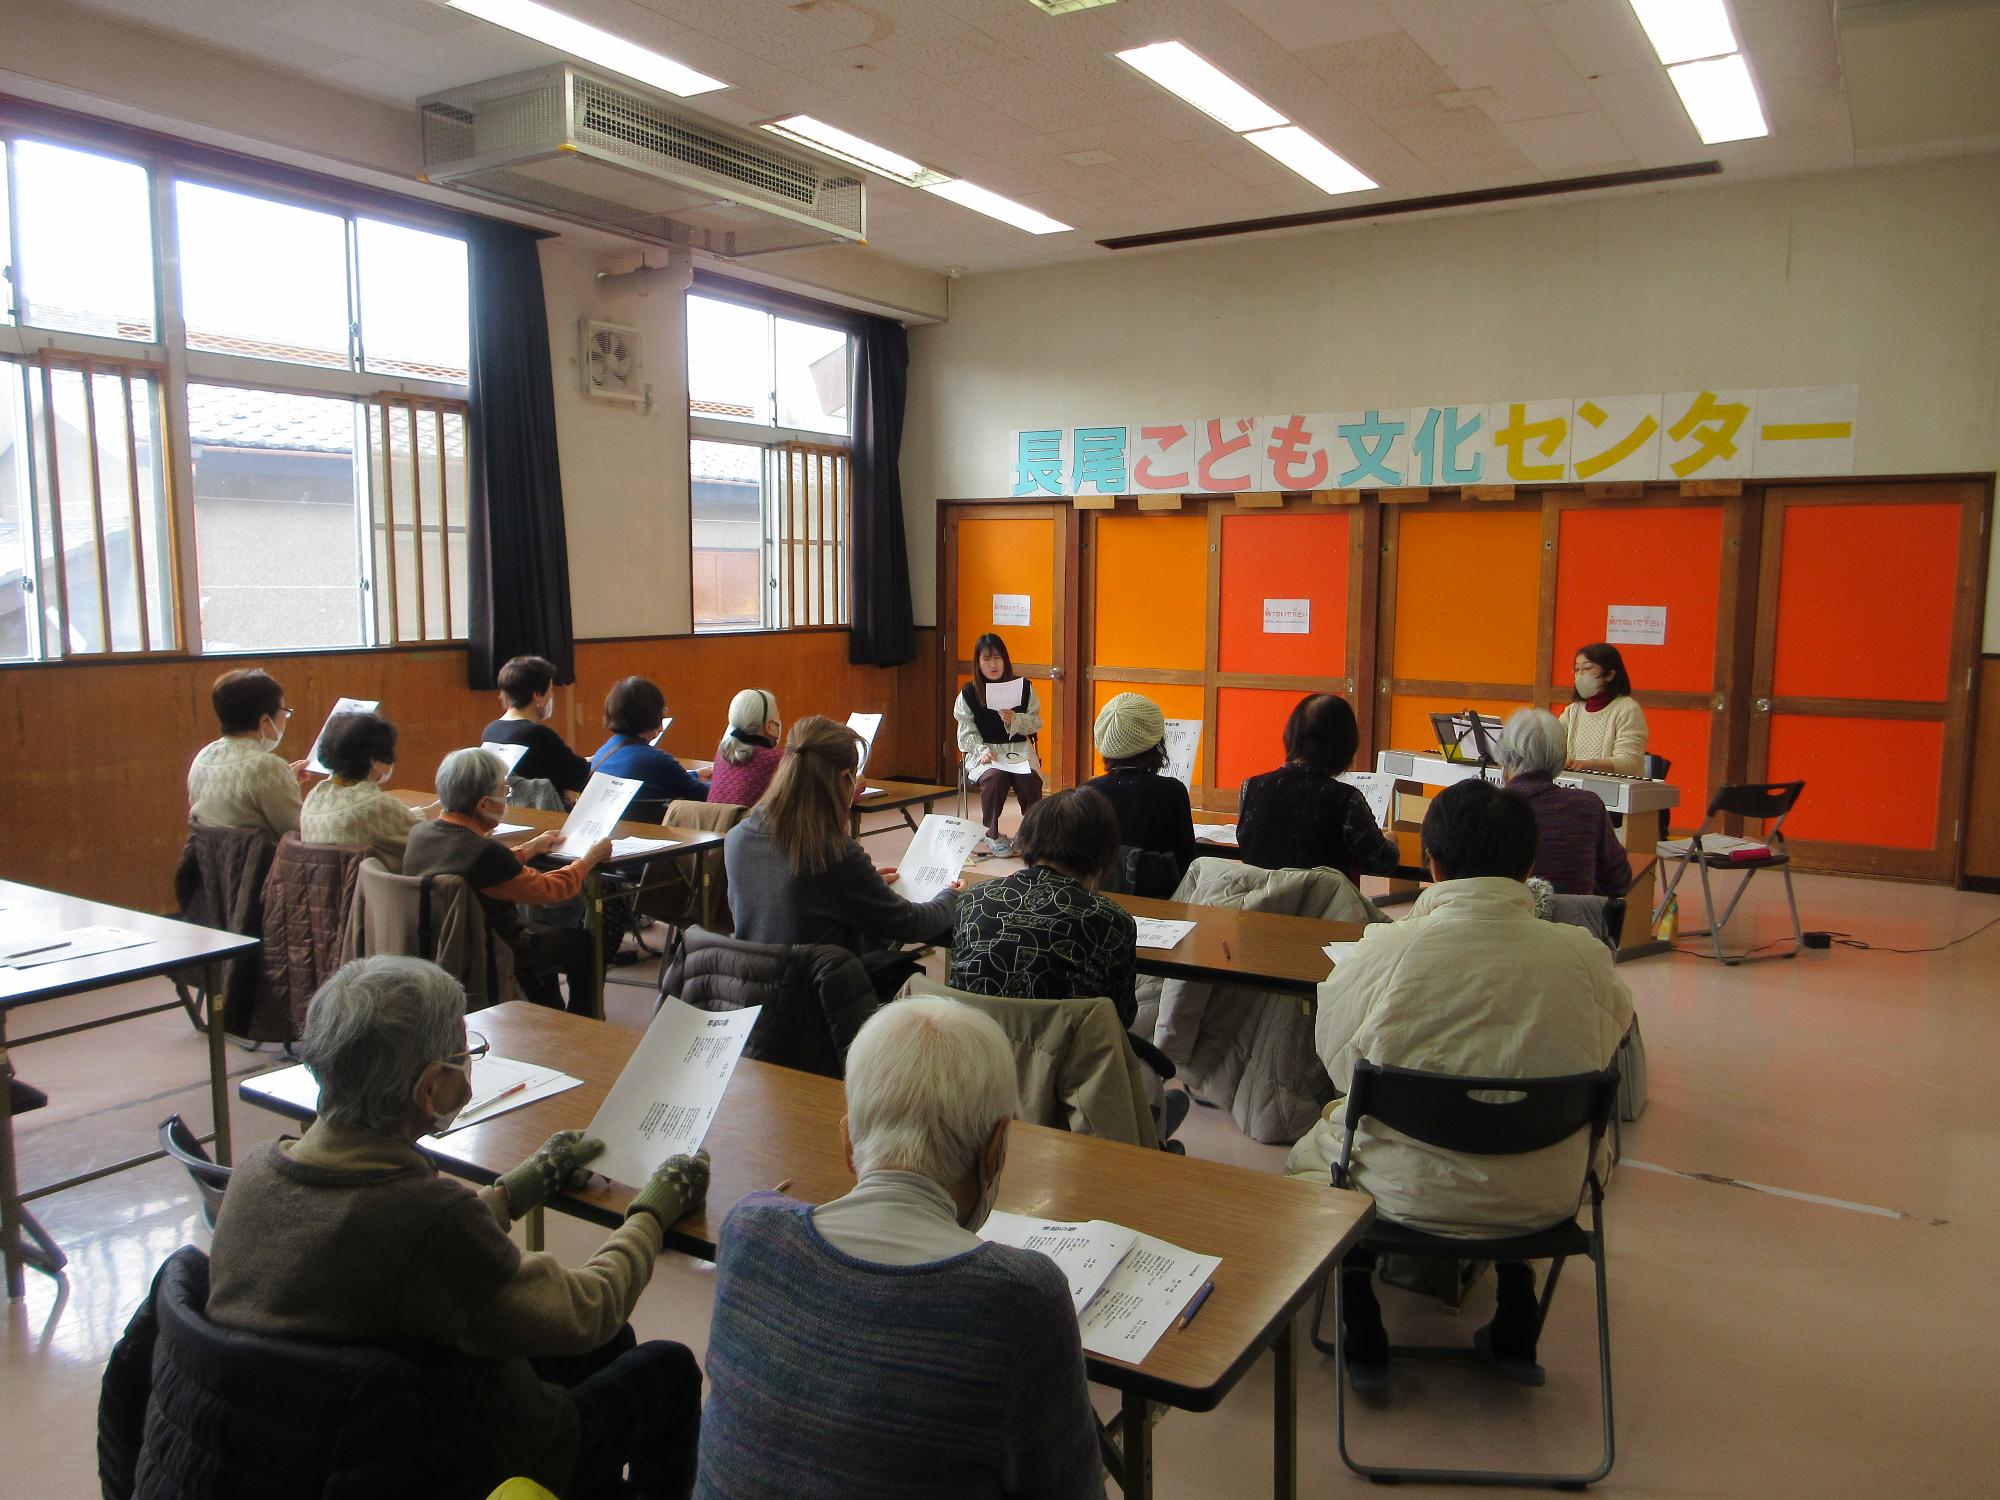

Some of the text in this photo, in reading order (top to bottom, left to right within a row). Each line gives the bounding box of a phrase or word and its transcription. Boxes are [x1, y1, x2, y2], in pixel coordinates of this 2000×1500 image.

[1012, 389, 1853, 497] 長尾こども文化センター
